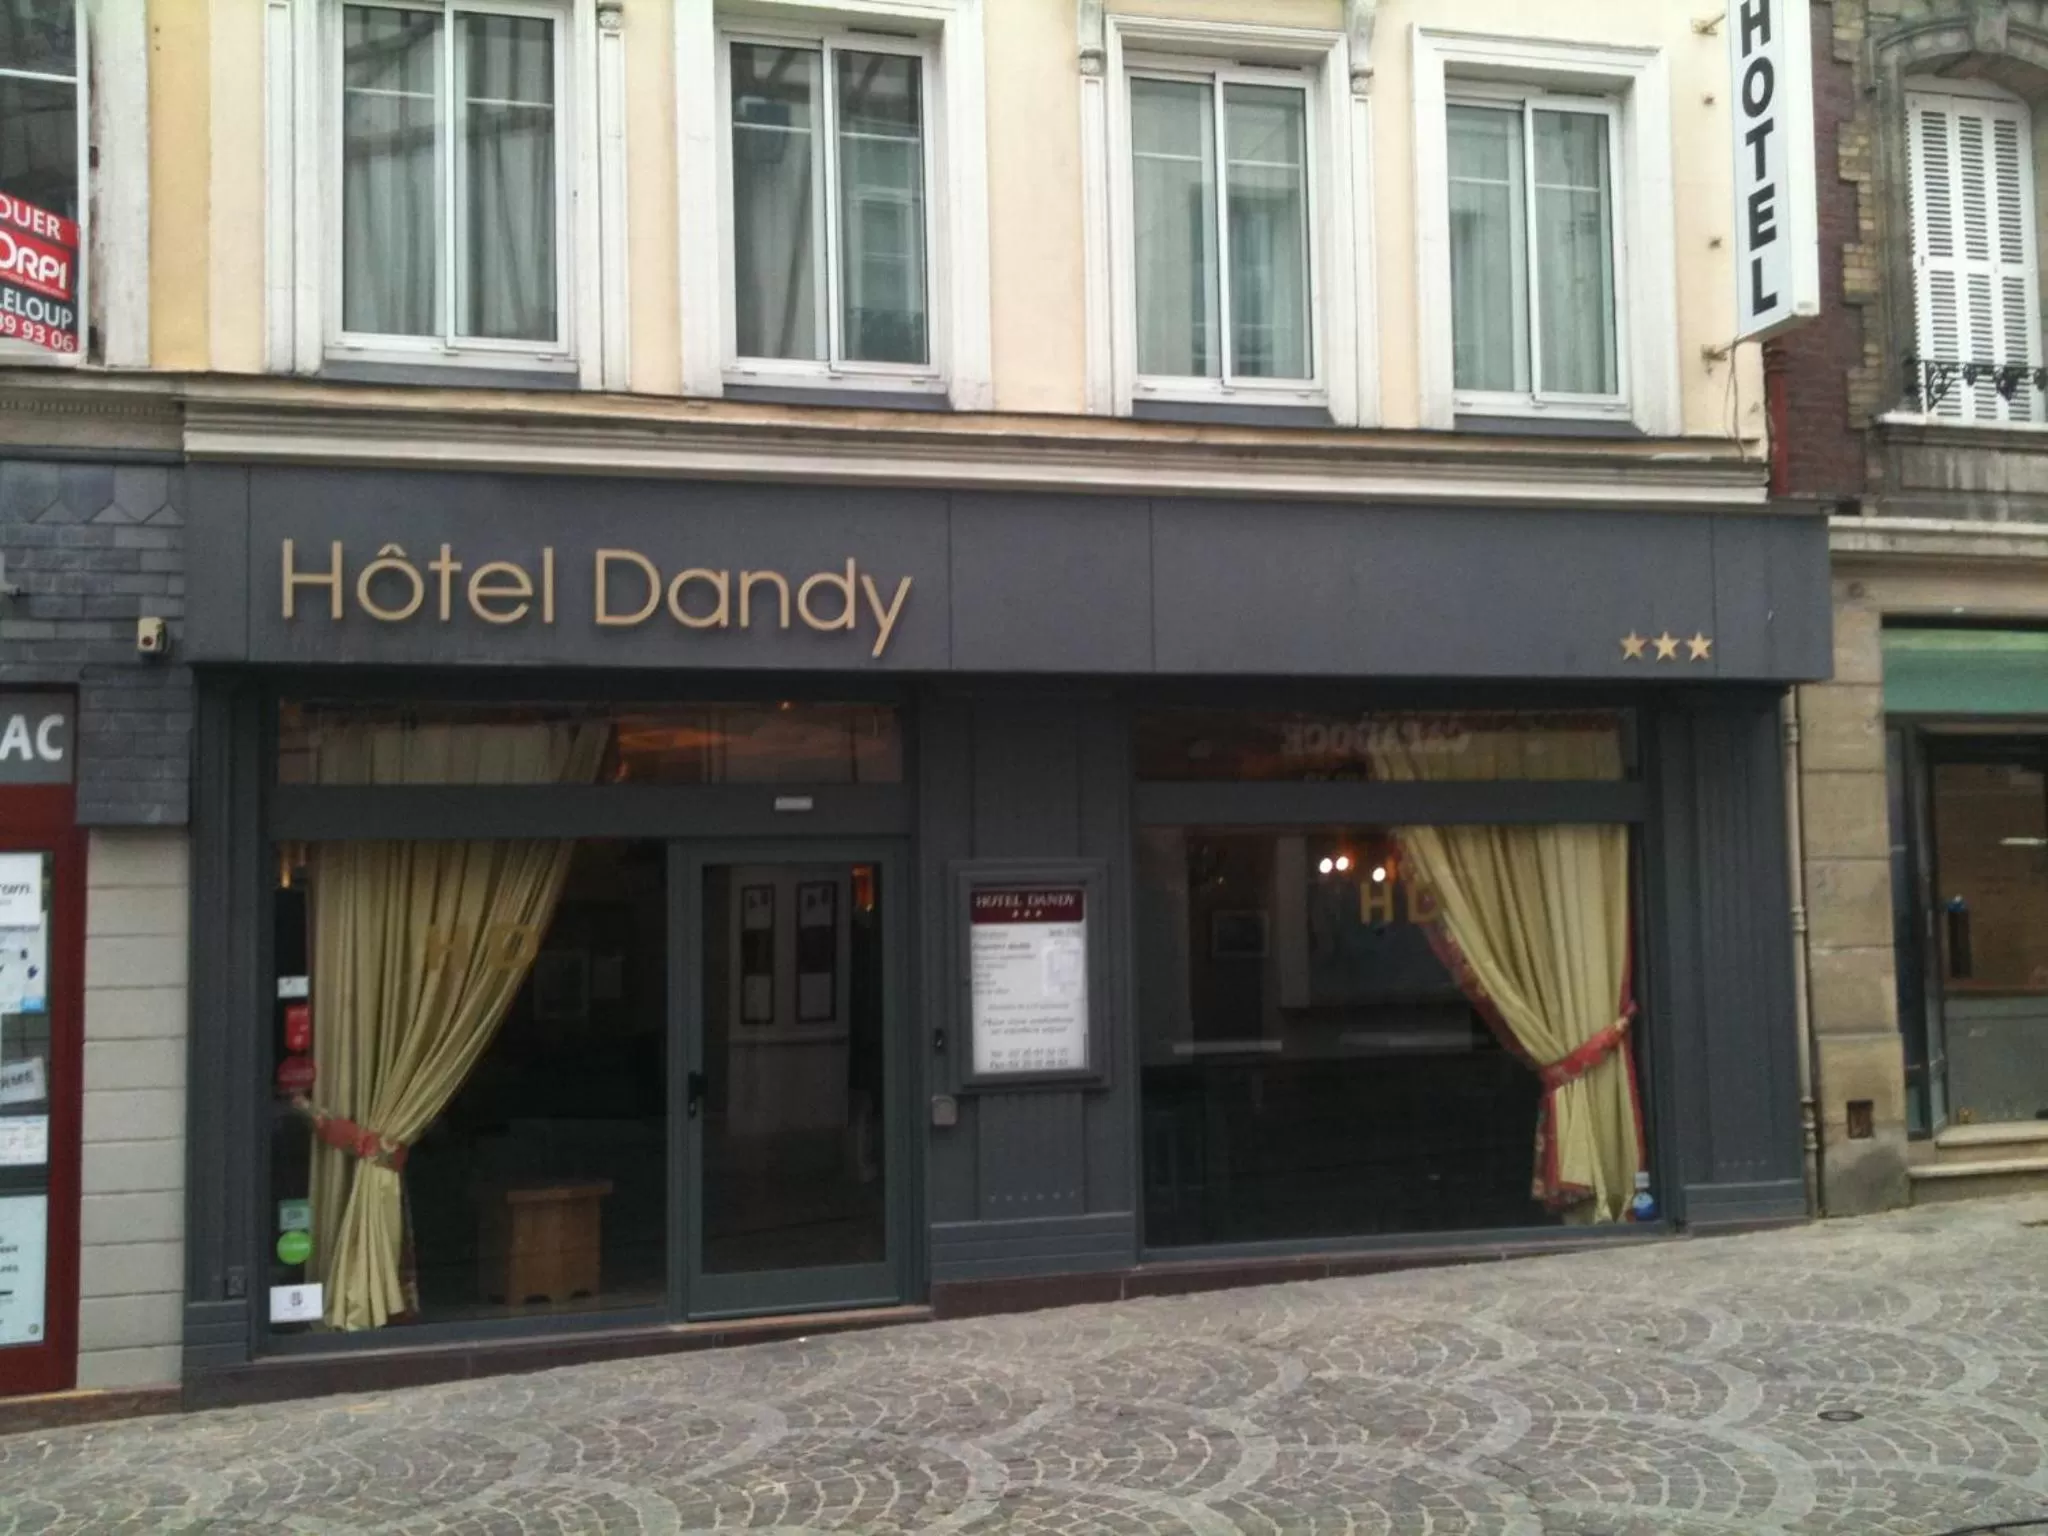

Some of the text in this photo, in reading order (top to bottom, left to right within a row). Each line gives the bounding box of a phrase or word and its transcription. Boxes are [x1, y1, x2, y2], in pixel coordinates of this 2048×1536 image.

[1740, 0, 1778, 316] HOTEL
[22, 320, 46, 343] 93
[50, 330, 74, 352] 06
[281, 537, 912, 658] Hôtel Dandy
[0, 714, 64, 761] AC
